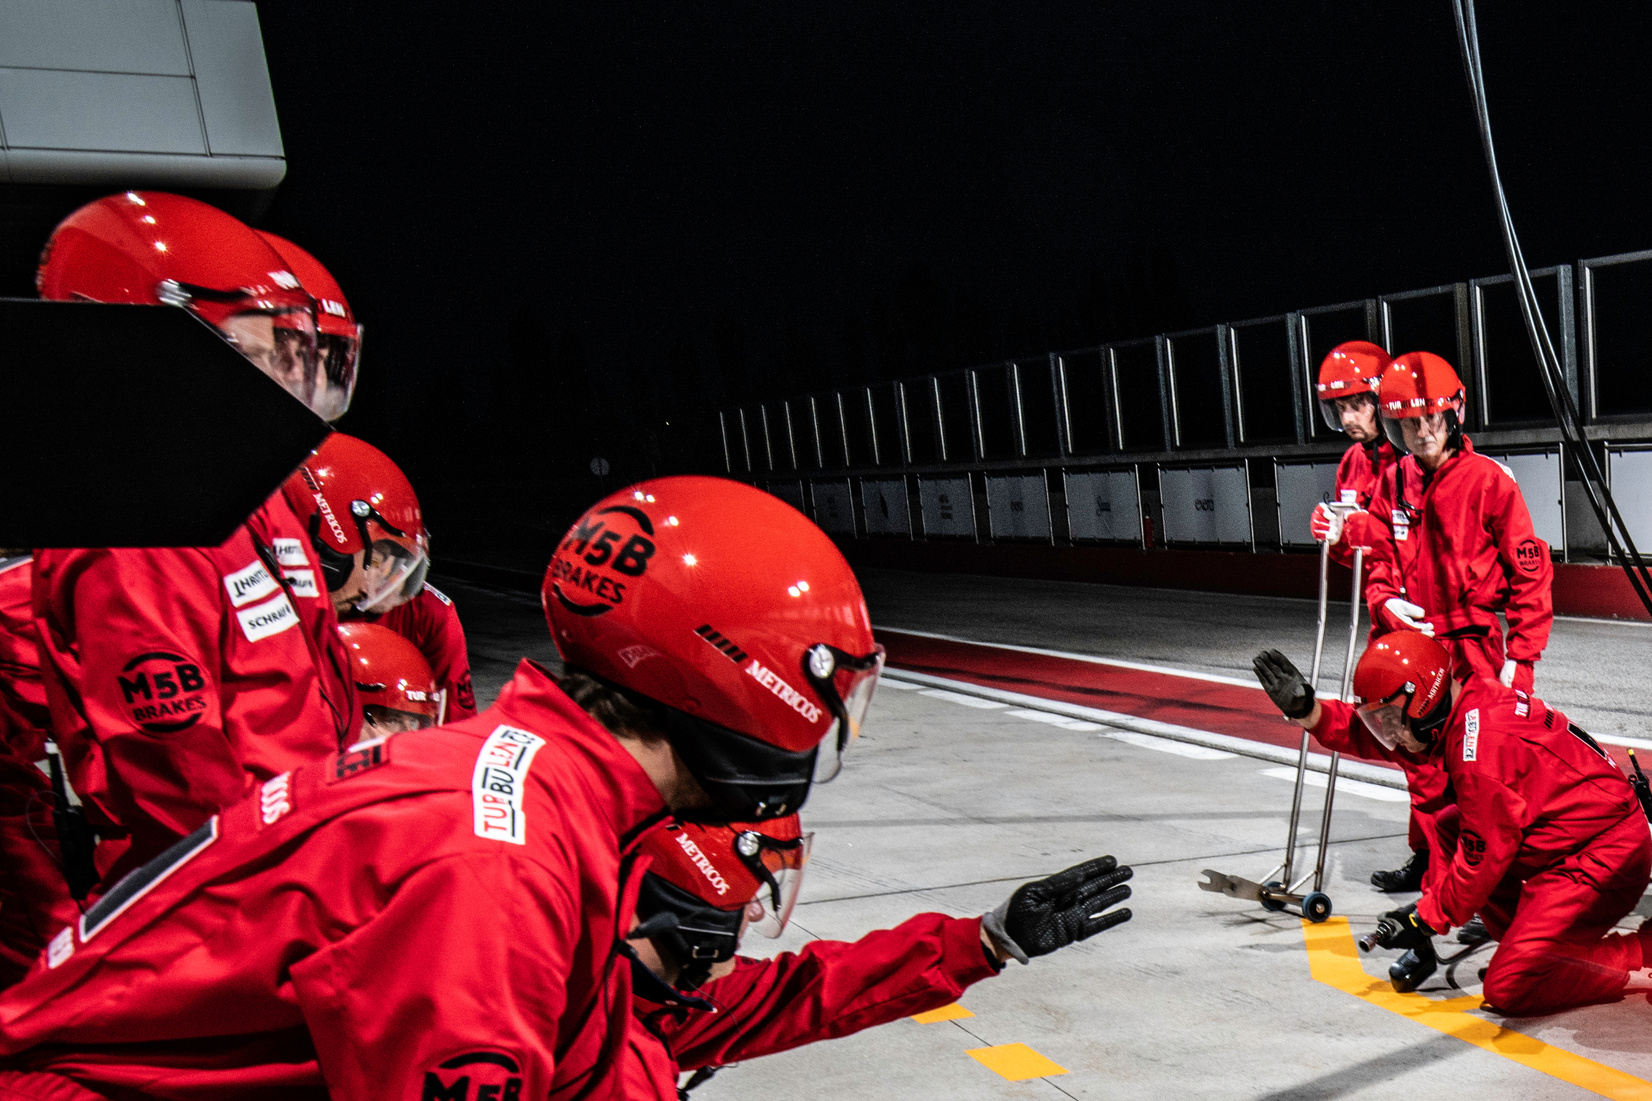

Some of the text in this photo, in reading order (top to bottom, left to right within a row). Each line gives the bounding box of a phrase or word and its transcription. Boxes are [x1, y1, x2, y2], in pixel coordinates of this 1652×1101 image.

[312, 492, 348, 545] METRICOS
[563, 516, 657, 577] M5B
[1516, 545, 1540, 559] M5B
[116, 663, 205, 704] M5B
[132, 695, 207, 722] BRAKES
[744, 659, 823, 725] METRICOS
[664, 832, 731, 896] METRICOS
